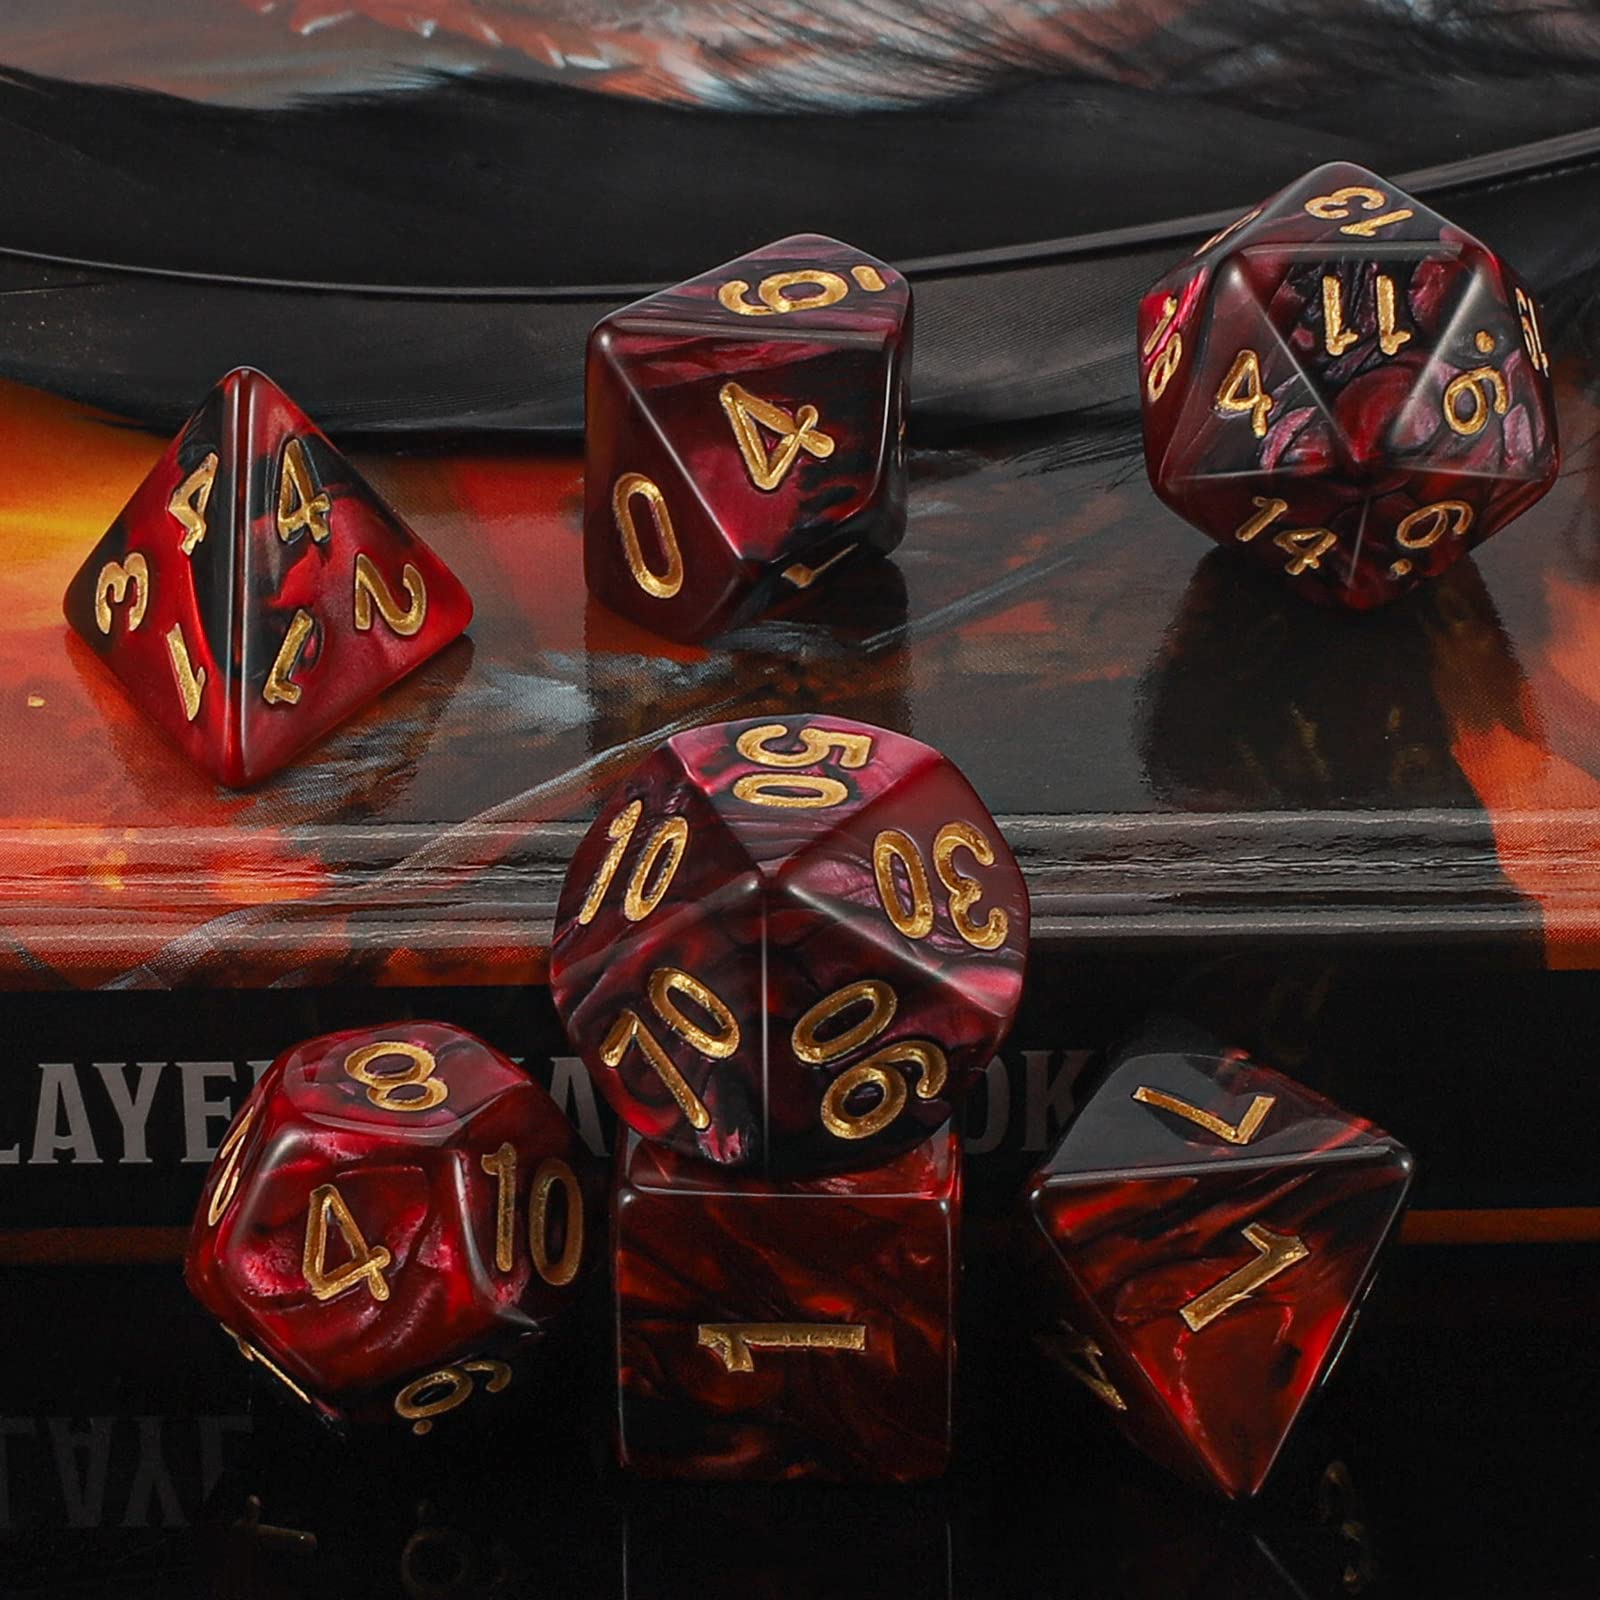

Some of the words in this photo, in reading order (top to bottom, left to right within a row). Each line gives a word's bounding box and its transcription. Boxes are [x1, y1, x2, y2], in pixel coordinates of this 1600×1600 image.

[1304, 186, 1413, 237] 13
[1322, 275, 1411, 356] 11
[719, 382, 835, 491] 4
[1216, 349, 1273, 437] 4
[168, 452, 219, 555] 4
[277, 437, 331, 543] 4
[612, 472, 684, 598] 0
[1234, 496, 1338, 576] 14
[95, 552, 149, 635] 3
[354, 553, 427, 636] 2
[166, 622, 205, 721] 1
[263, 608, 314, 705] 1
[732, 724, 873, 808] 50
[577, 800, 688, 924] 10
[873, 820, 1009, 950] 30
[345, 1041, 448, 1111] 8
[600, 967, 741, 1129] 70
[0, 1060, 274, 1164] AYE
[1133, 1085, 1276, 1144] 7
[302, 1183, 391, 1301] 4
[481, 1142, 584, 1286] 10
[1180, 1222, 1310, 1332] 1
[698, 1324, 866, 1372] 1
